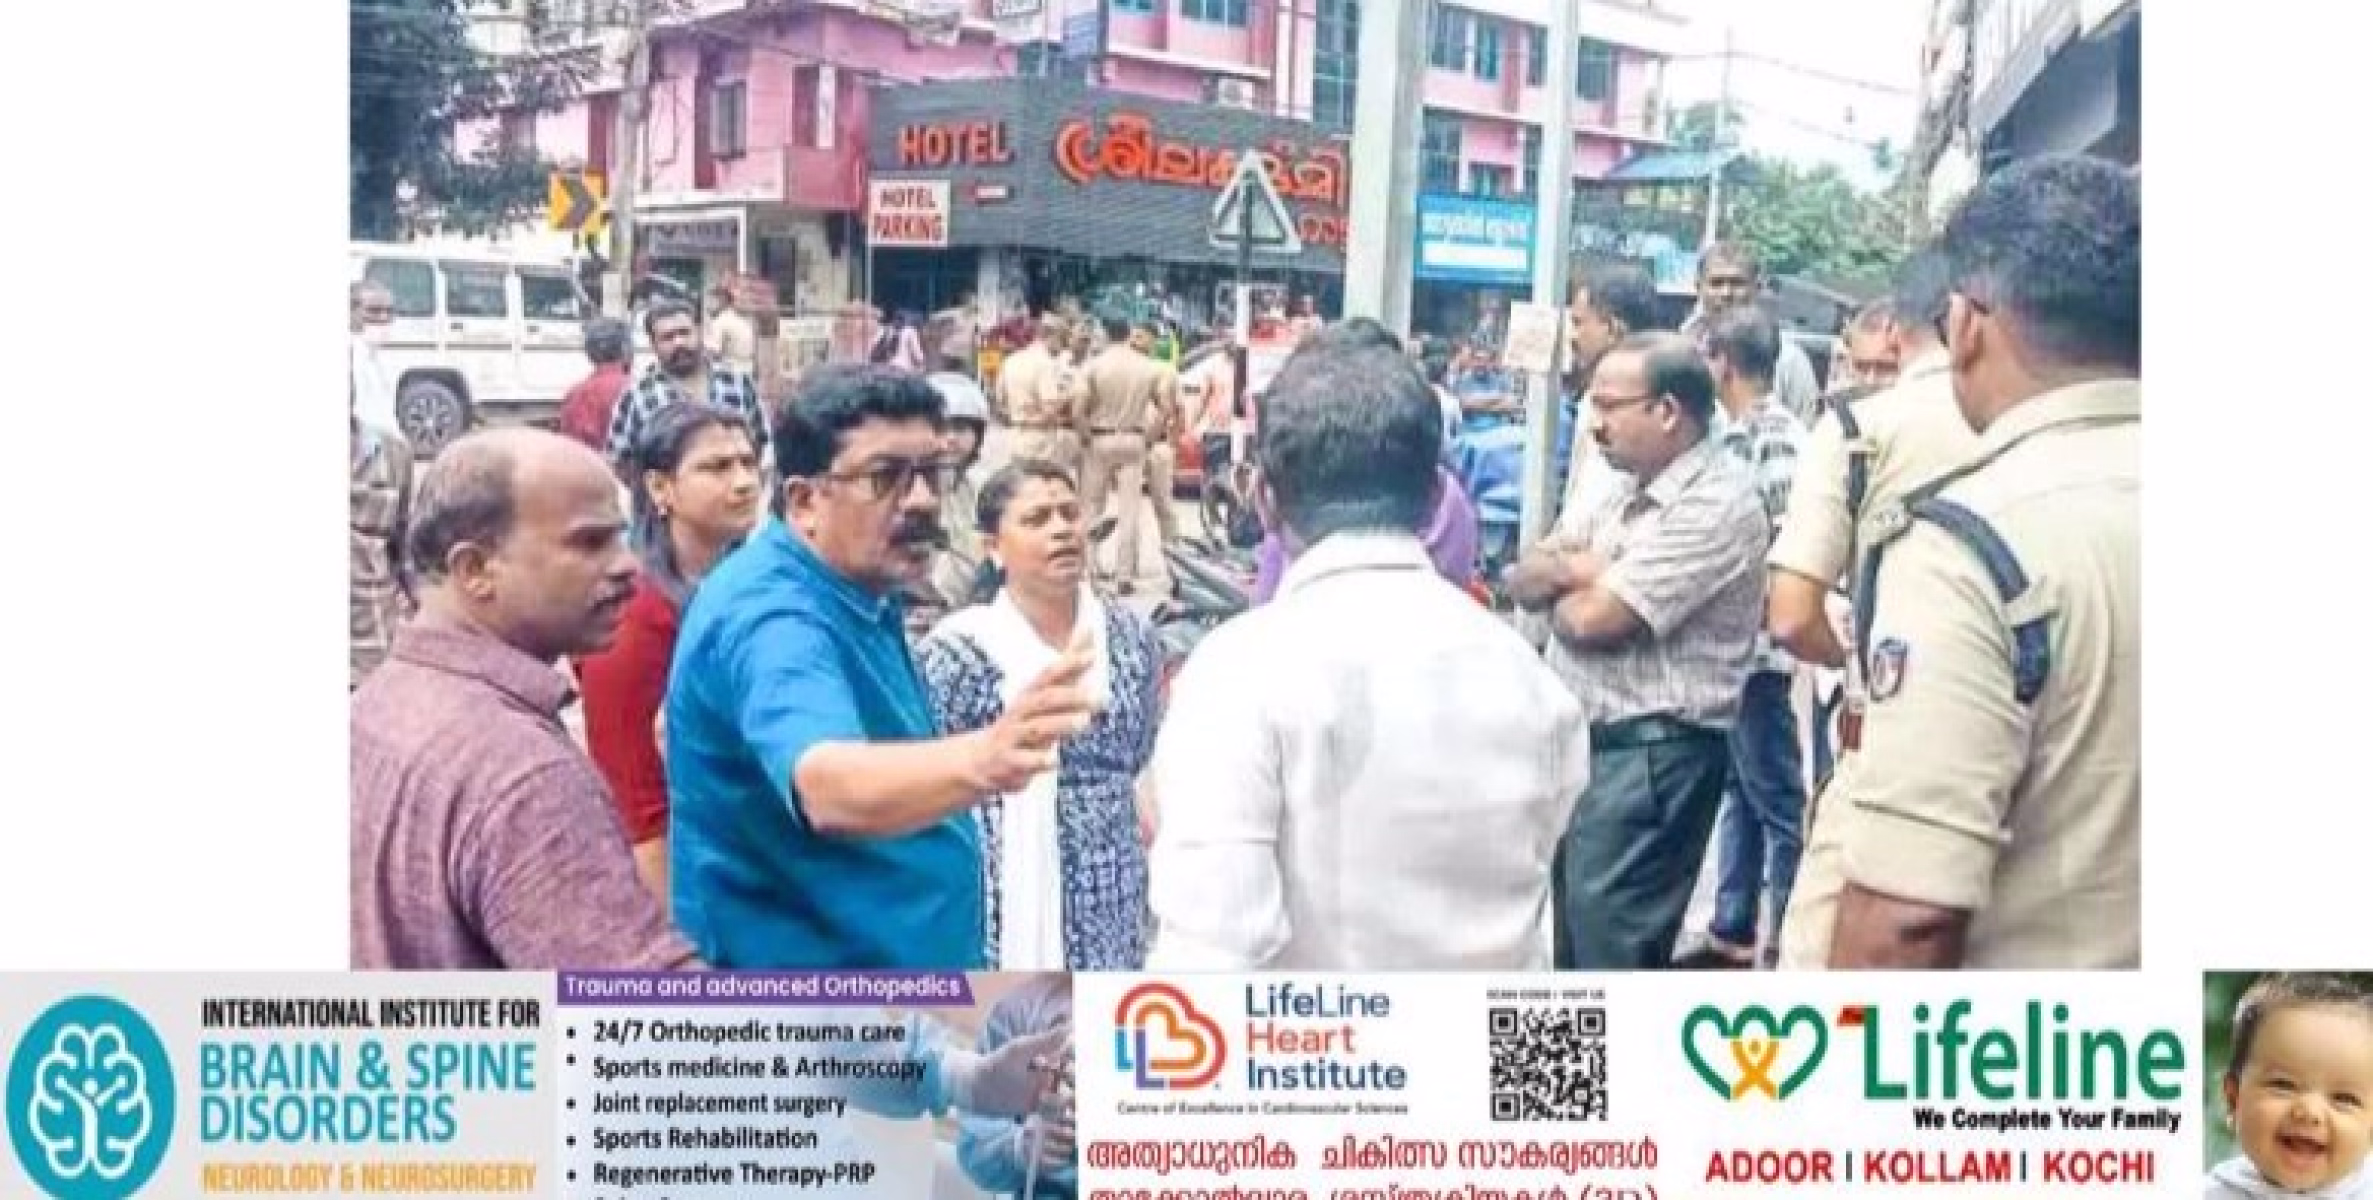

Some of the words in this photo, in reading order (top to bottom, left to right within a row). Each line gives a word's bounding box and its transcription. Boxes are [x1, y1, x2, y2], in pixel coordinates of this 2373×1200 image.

[899, 122, 1013, 164] HOTEL
[880, 187, 936, 209] HOTEL
[873, 212, 942, 240] PARKING
